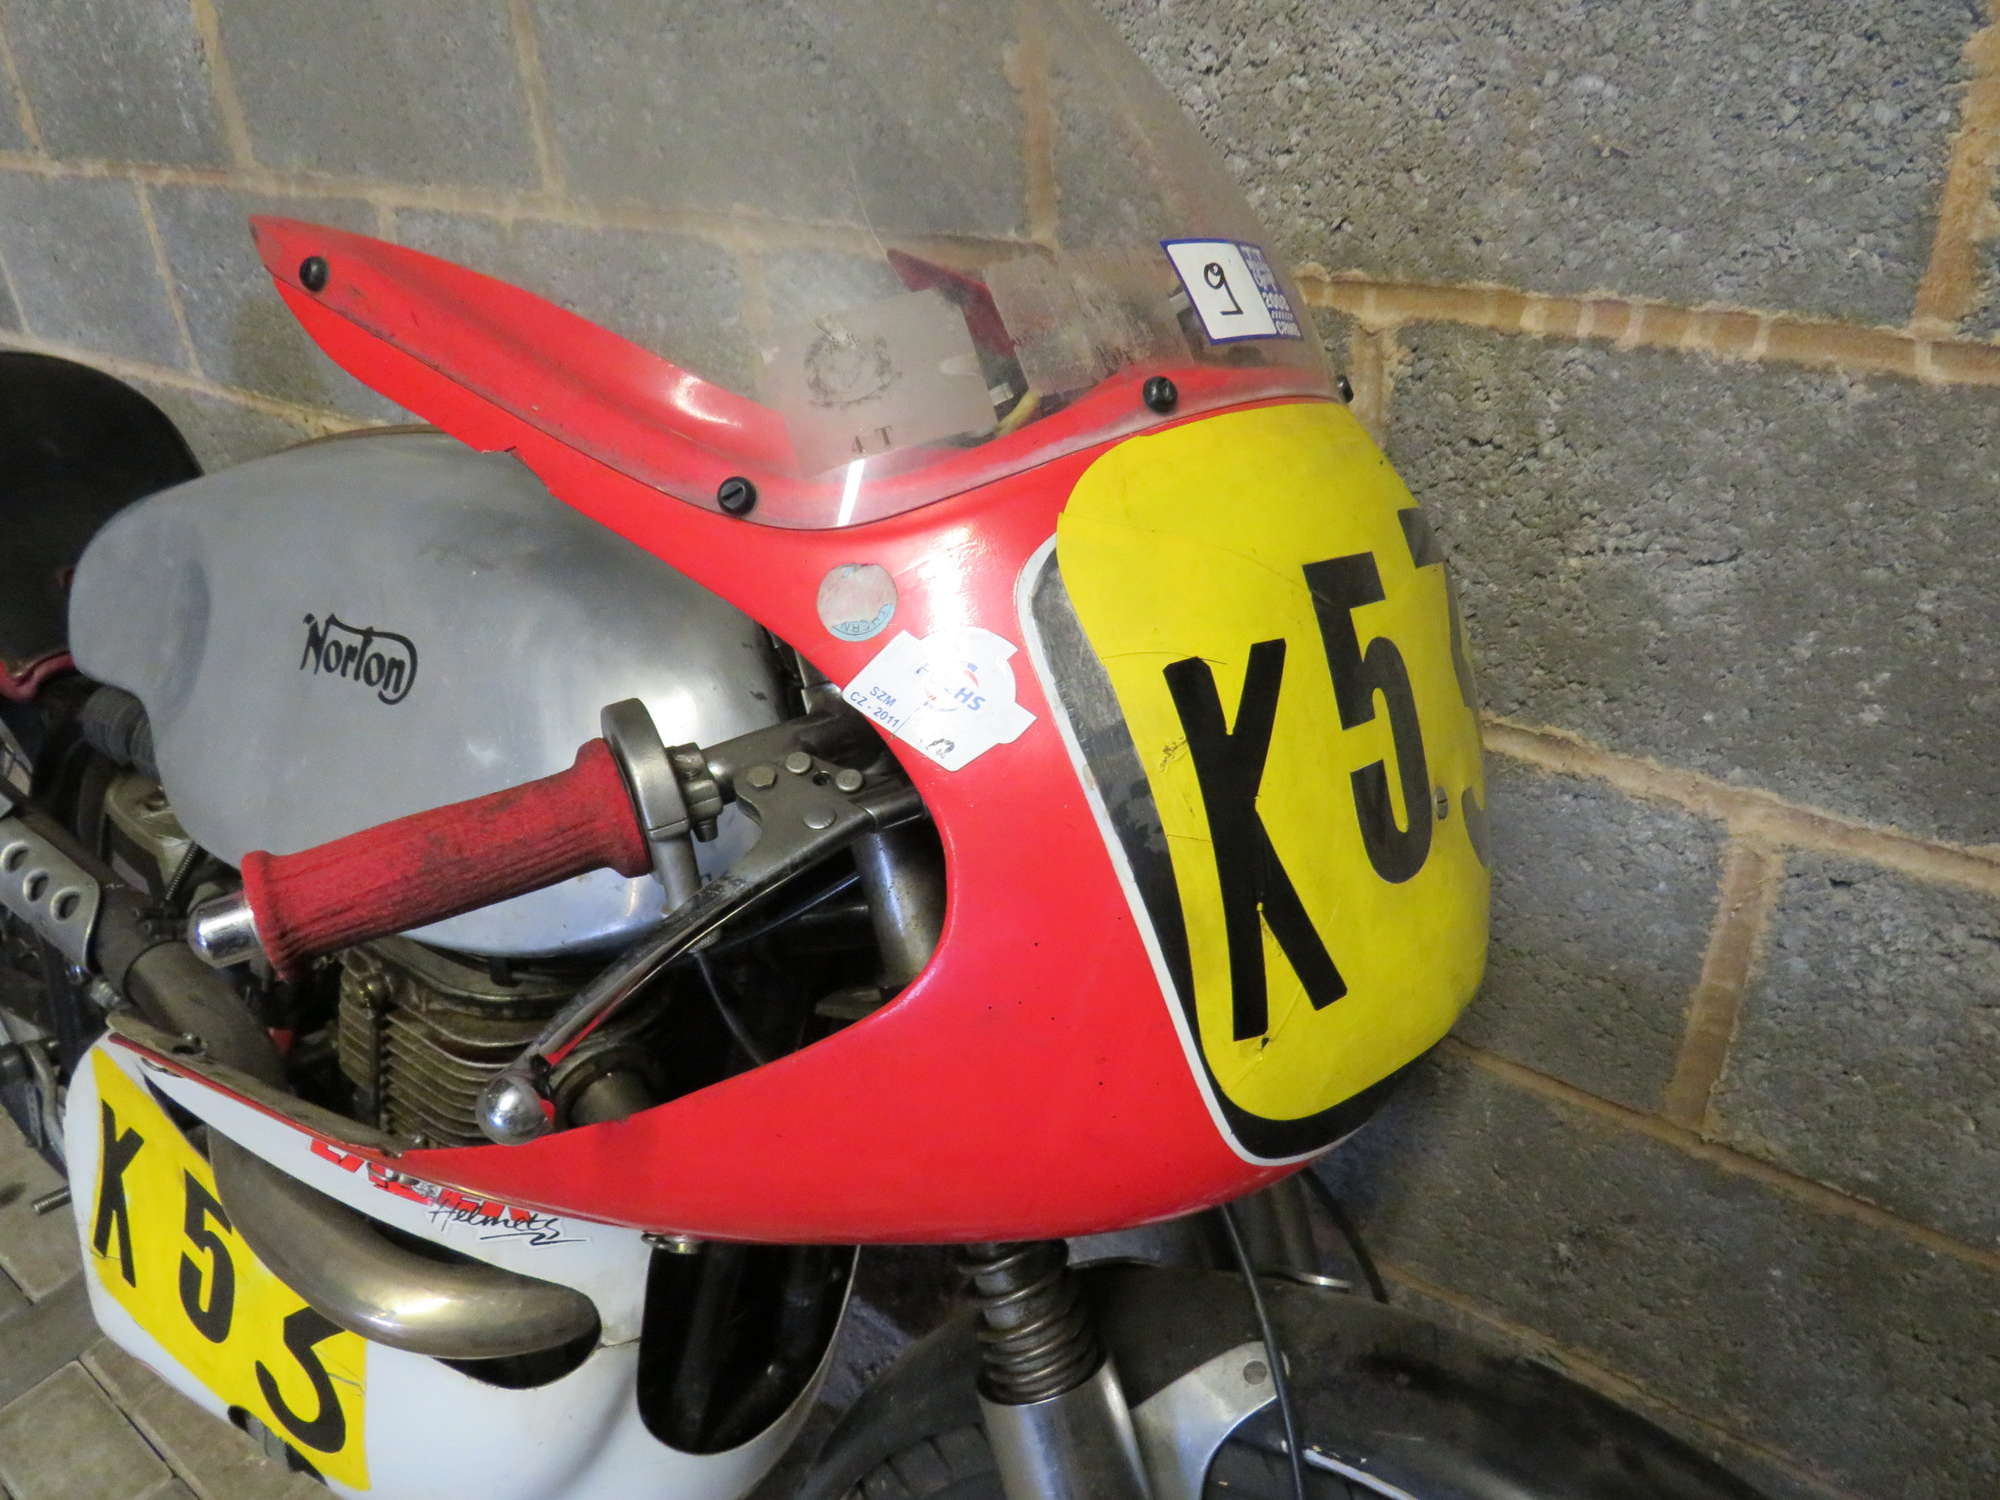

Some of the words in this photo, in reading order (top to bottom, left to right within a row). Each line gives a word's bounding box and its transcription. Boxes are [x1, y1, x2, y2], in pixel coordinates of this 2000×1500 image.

[300, 613, 418, 705] Norton
[850, 691, 868, 707] CZ
[873, 707, 900, 728] 2011
[870, 686, 897, 706] SZM
[428, 1199, 568, 1240] Helmets
